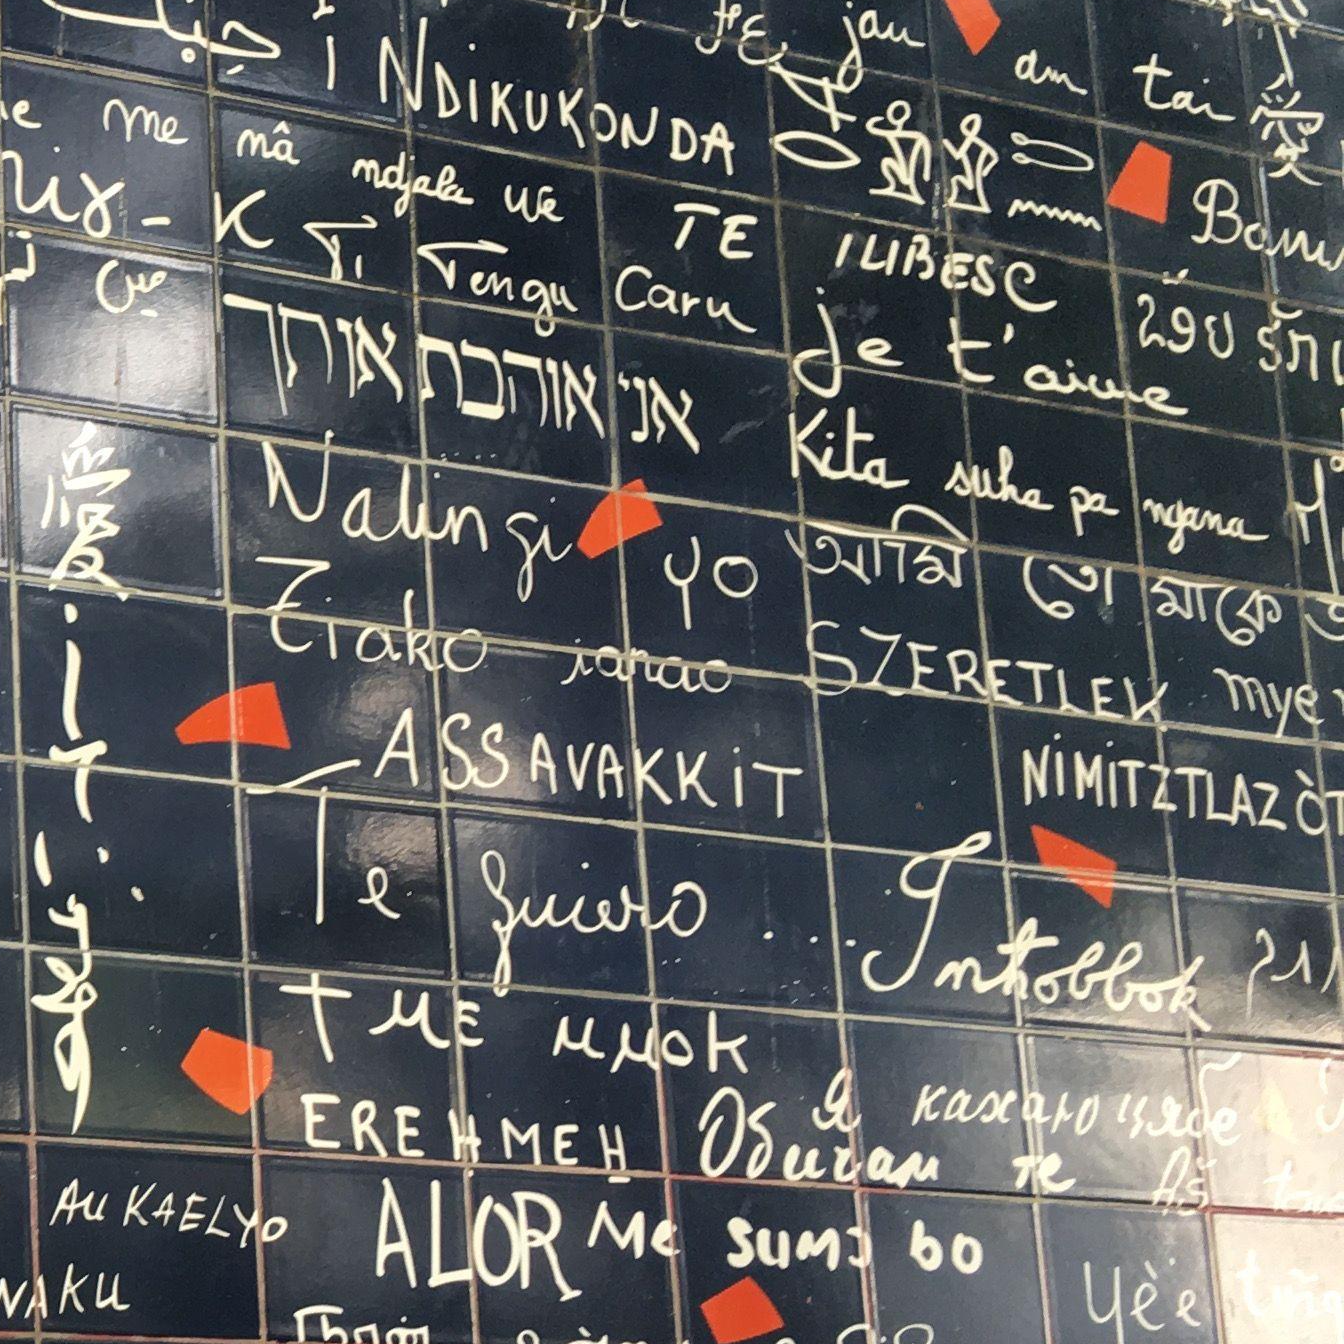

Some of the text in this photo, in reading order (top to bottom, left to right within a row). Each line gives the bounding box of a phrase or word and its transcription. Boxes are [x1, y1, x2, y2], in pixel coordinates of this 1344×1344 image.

[613, 264, 758, 335] Caru
[673, 202, 1058, 312] TE IUBESC
[373, 706, 805, 819] ASSAVAKKIT
